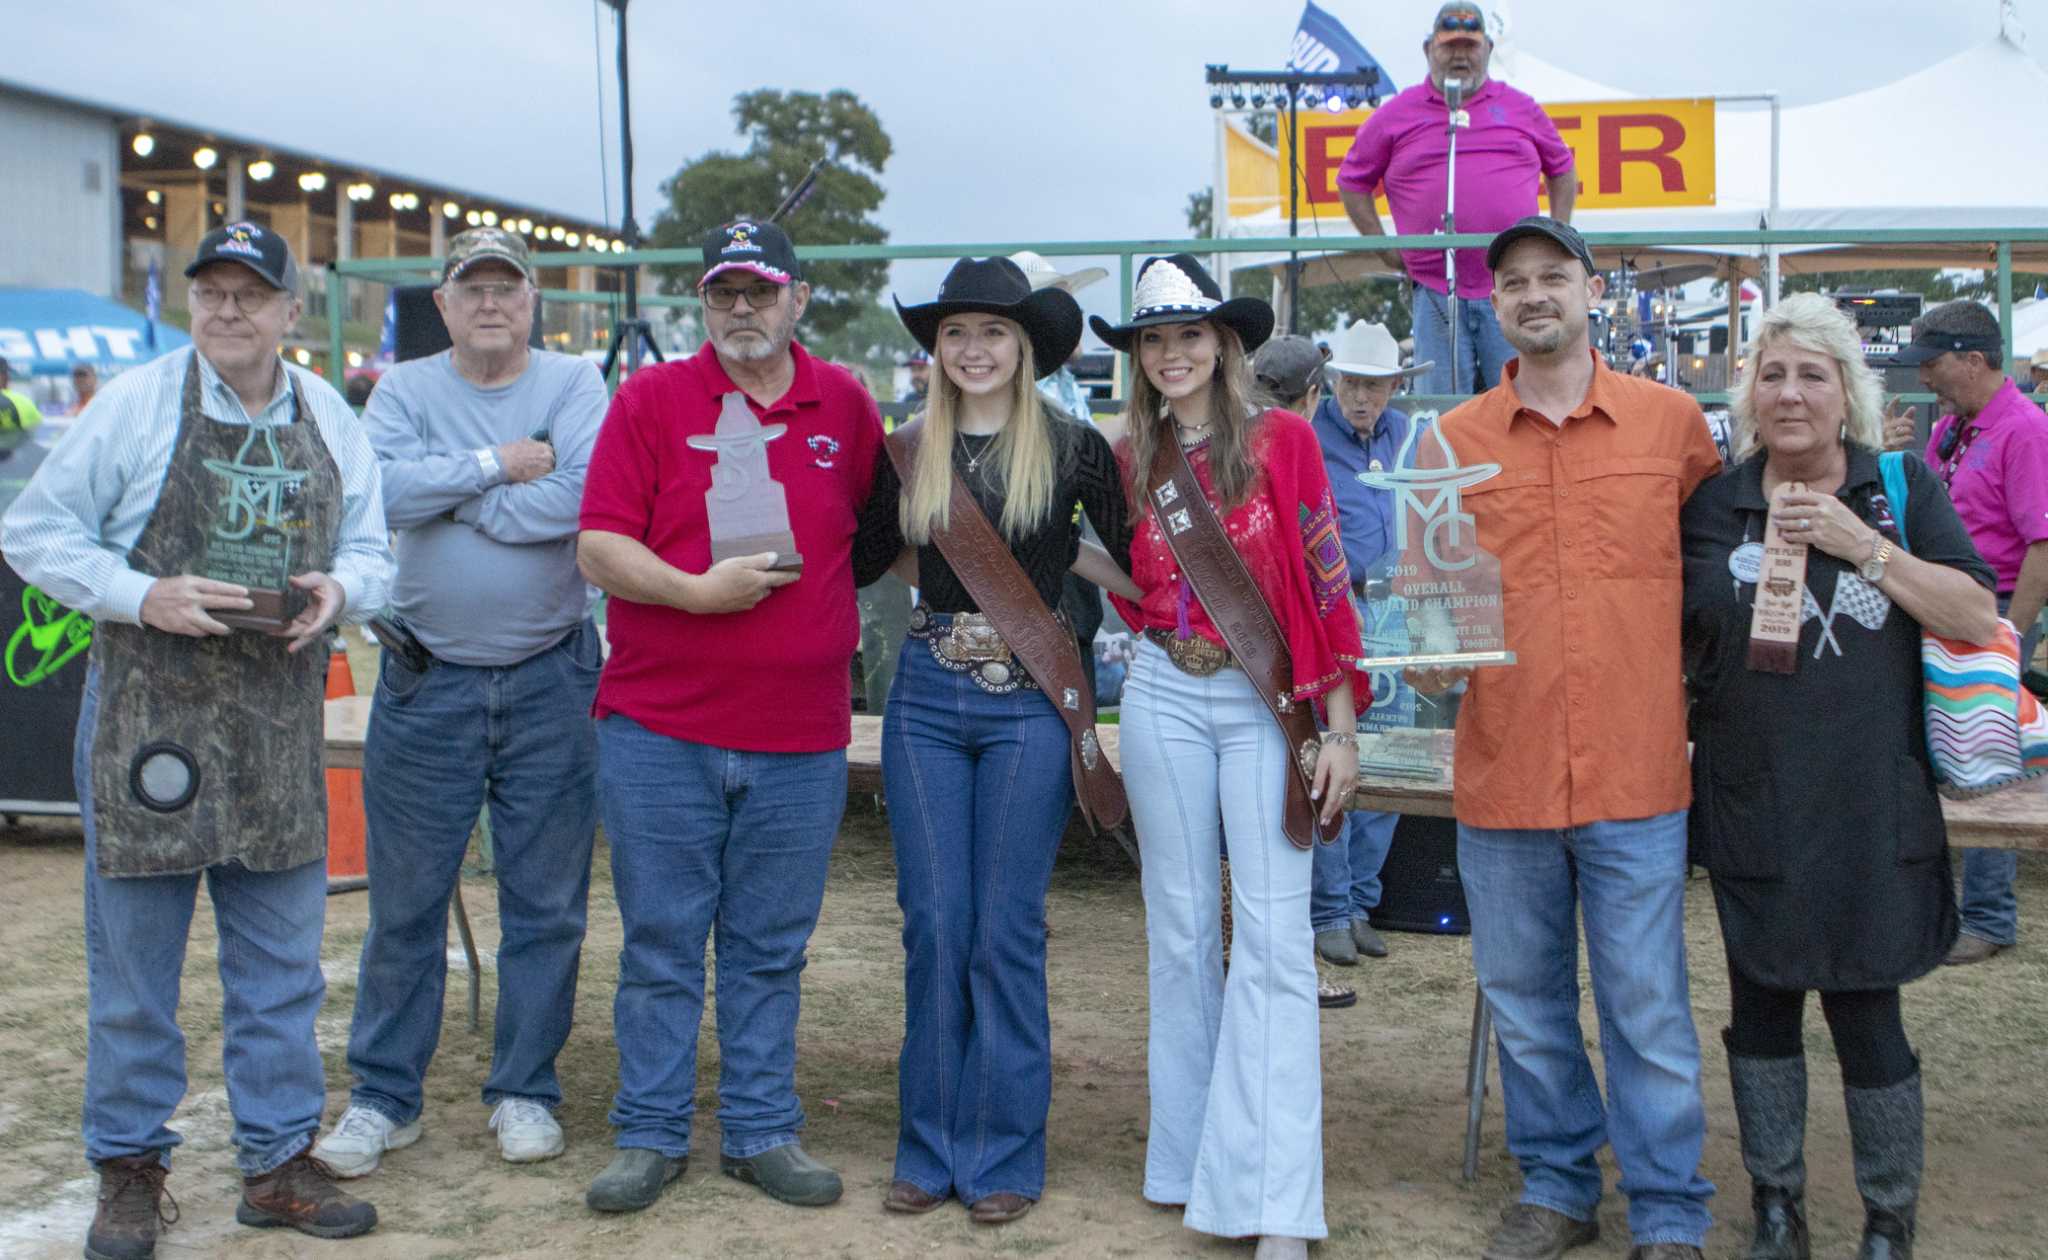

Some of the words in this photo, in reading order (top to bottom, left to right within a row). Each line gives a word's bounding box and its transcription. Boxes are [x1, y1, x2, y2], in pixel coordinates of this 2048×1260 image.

[1386, 564, 1418, 578] 2019
[1404, 580, 1467, 596] OVERALL
[1424, 593, 1498, 610] CHAMPION
